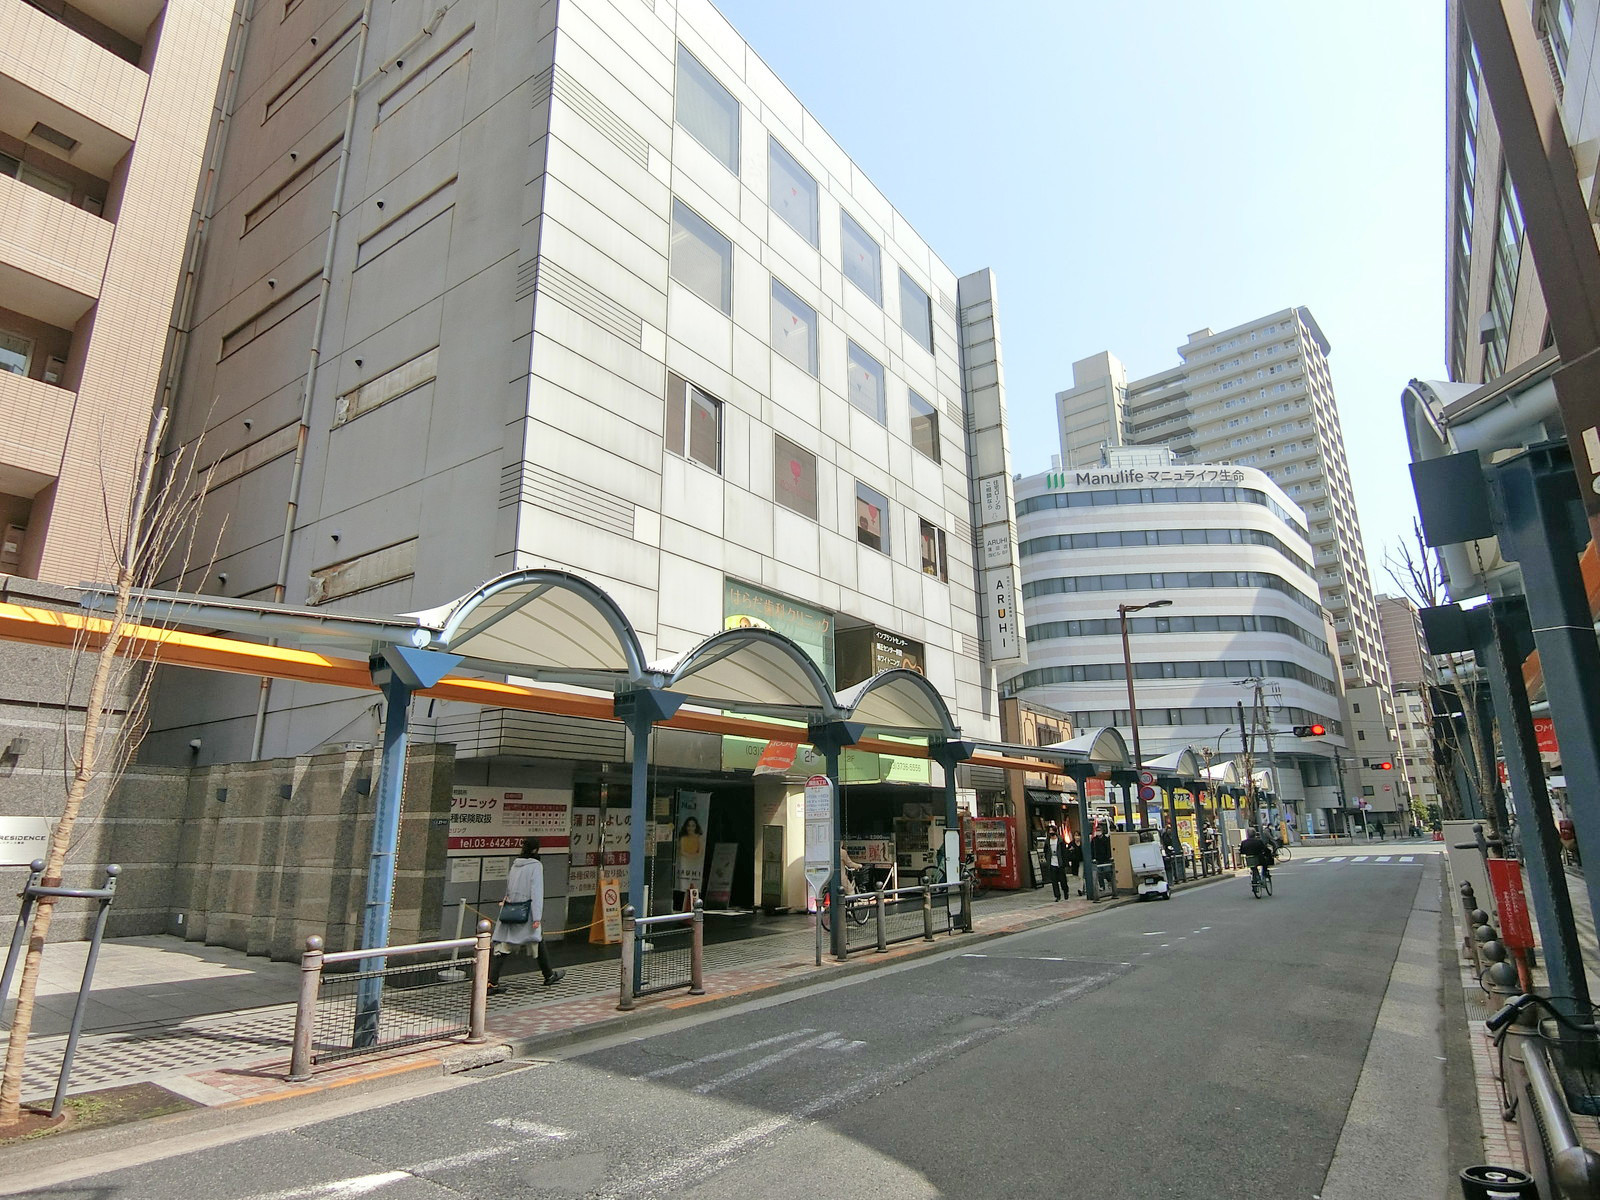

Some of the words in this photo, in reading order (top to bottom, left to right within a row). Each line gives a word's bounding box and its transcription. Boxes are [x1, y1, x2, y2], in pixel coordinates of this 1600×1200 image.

[1076, 469, 1144, 486] Manulife
[1147, 469, 1245, 483] マニュライフ生命
[987, 537, 1008, 547] ARUHI
[730, 588, 829, 633] はらだ歯科クリニック
[996, 579, 1008, 648] ARUHI
[460, 838, 524, 848] tel.03-6424-70
